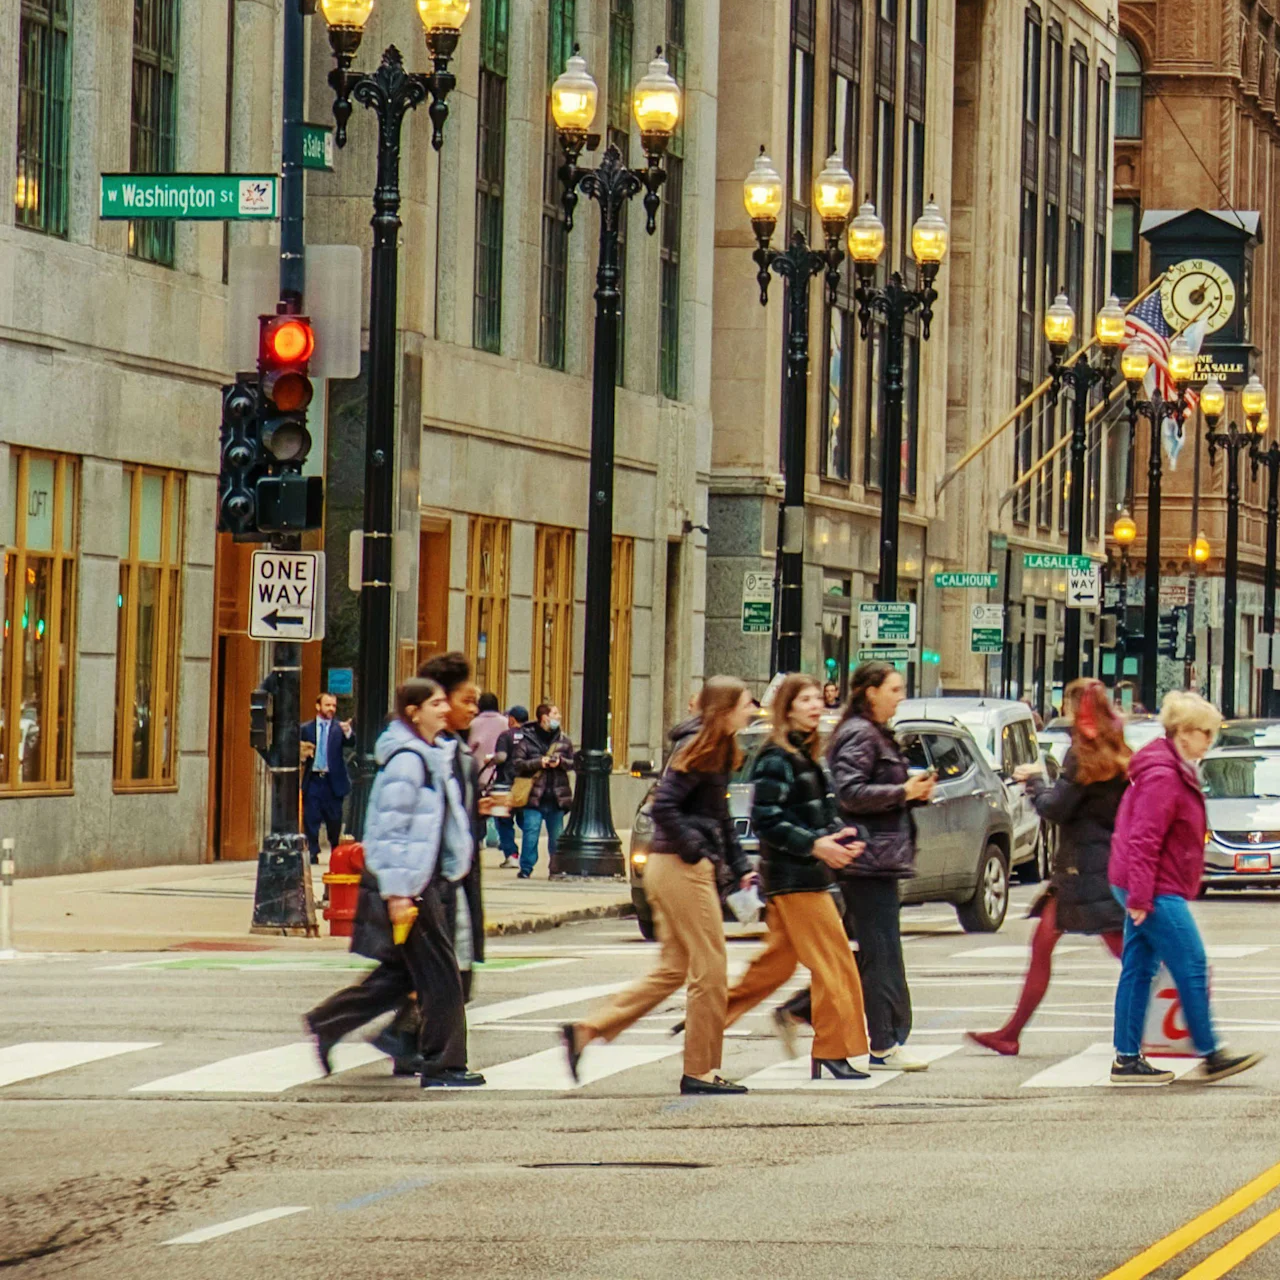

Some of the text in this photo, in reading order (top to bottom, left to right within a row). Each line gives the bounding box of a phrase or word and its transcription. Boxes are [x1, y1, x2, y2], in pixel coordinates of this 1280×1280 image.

[122, 184, 215, 215] Washington
[220, 189, 233, 203] St
[28, 489, 48, 518] LOFT
[260, 560, 307, 580] ONE
[1029, 556, 1078, 569] LASALLE
[1071, 566, 1095, 577] ONE
[942, 574, 991, 587] CALHOUN
[1070, 579, 1095, 589] WAY
[258, 583, 307, 605] WAY
